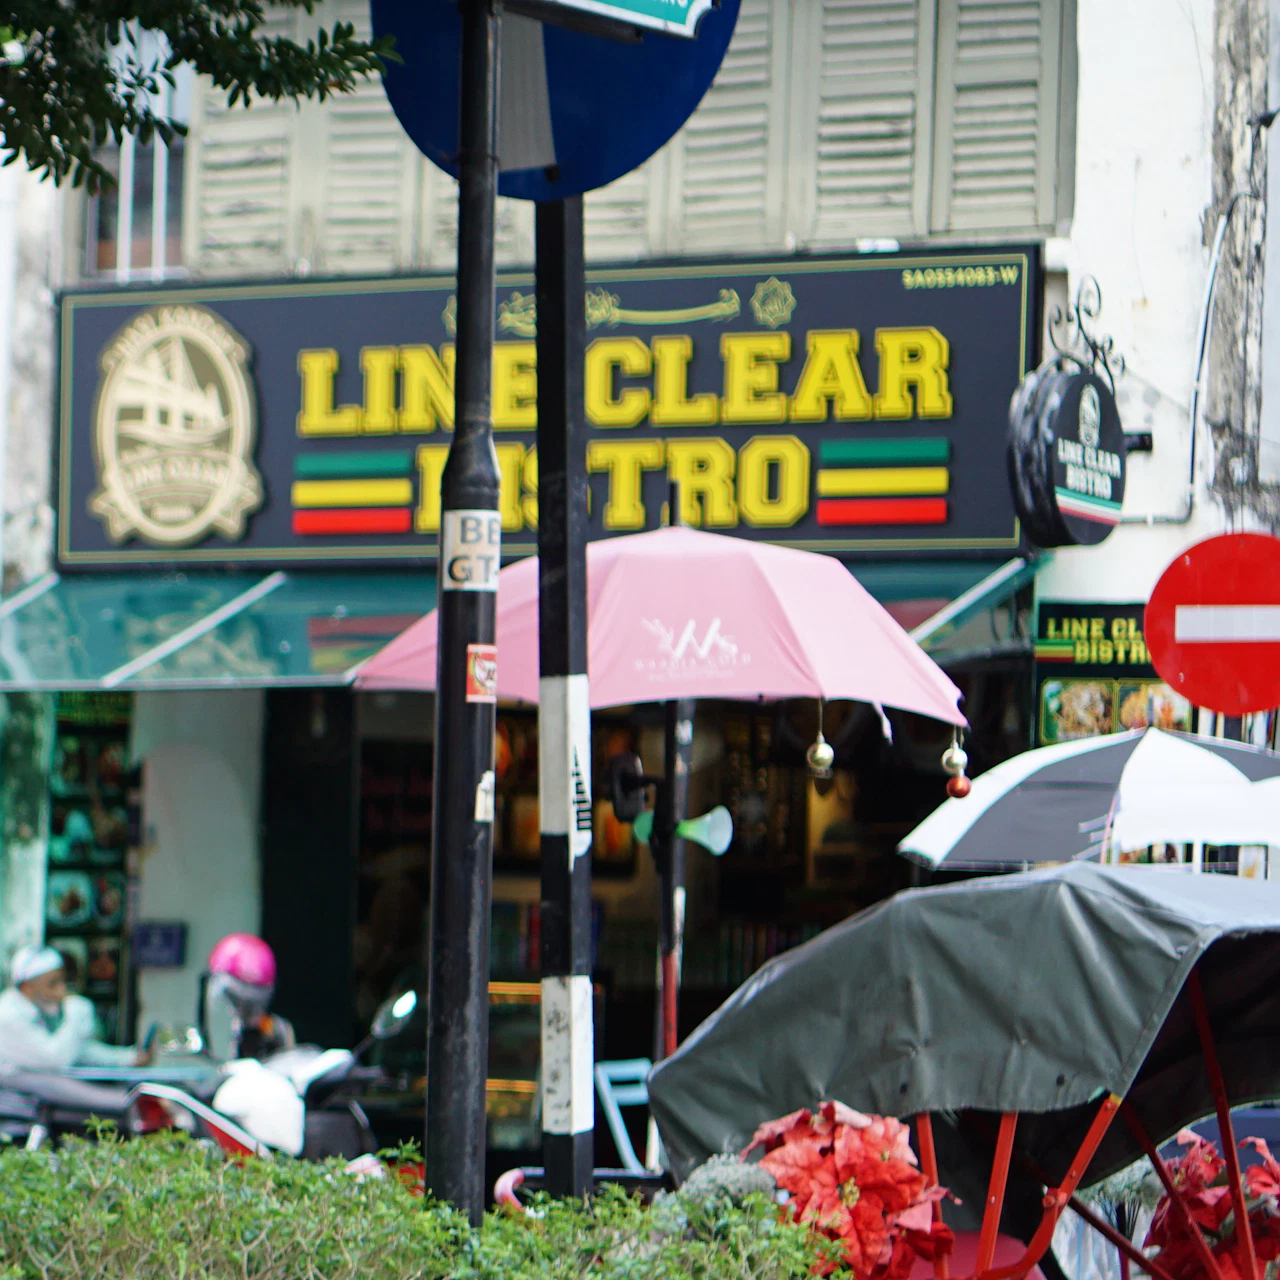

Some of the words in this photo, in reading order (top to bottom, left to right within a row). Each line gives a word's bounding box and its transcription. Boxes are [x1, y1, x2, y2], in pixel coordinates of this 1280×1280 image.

[296, 340, 537, 438] LINE
[585, 326, 953, 429] CLEAR
[1057, 437, 1085, 467] LINE
[1084, 446, 1122, 478] CLEAR
[413, 434, 811, 533] ITRO
[1066, 464, 1113, 500] BISTRO
[1046, 617, 1105, 640] LINE
